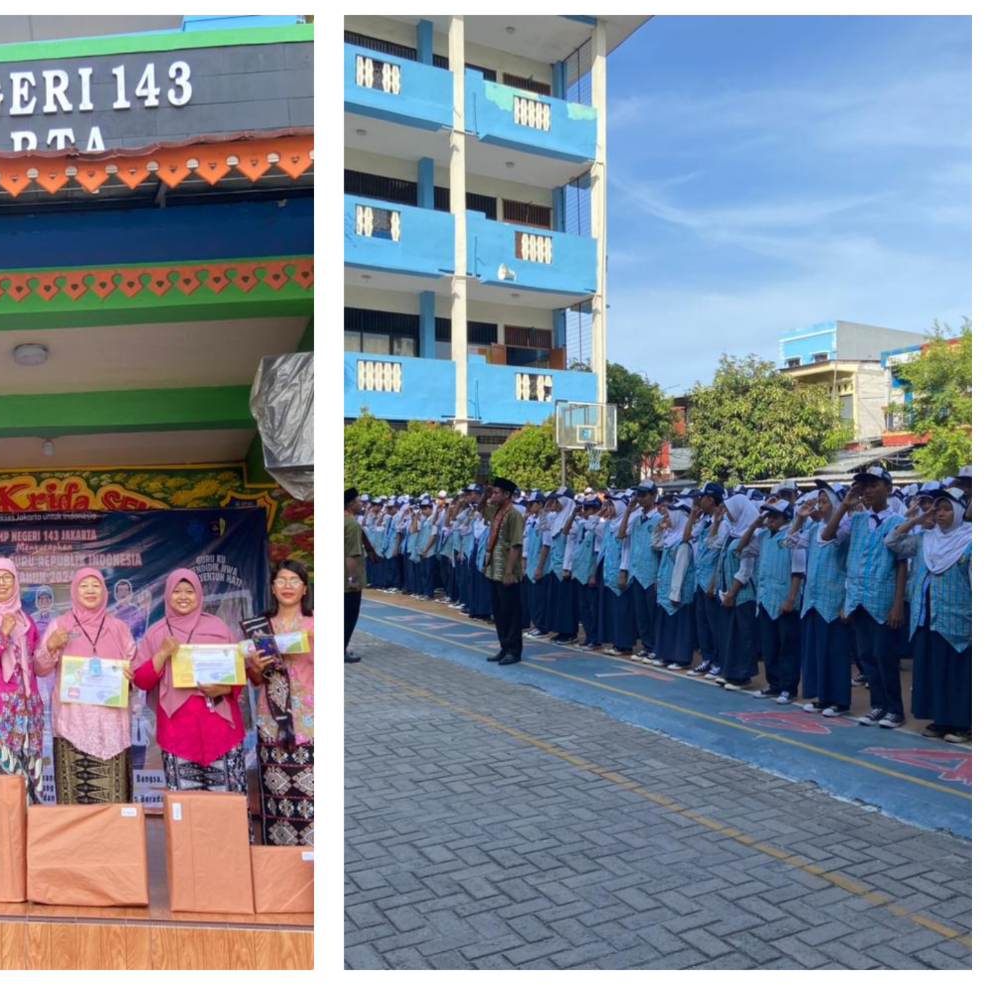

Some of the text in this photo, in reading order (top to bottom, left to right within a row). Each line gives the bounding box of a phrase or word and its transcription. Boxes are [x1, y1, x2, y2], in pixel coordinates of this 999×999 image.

[112, 61, 193, 110] 143
[11, 530, 41, 542] NEGERI
[43, 529, 59, 540] 143
[61, 529, 97, 540] JAKARTA
[38, 555, 86, 568] REPUBLIK
[88, 553, 142, 567] INDONESIA
[196, 554, 227, 565] GURU KU
[190, 563, 220, 573] ENDIDIK
[226, 573, 243, 588] HATI
